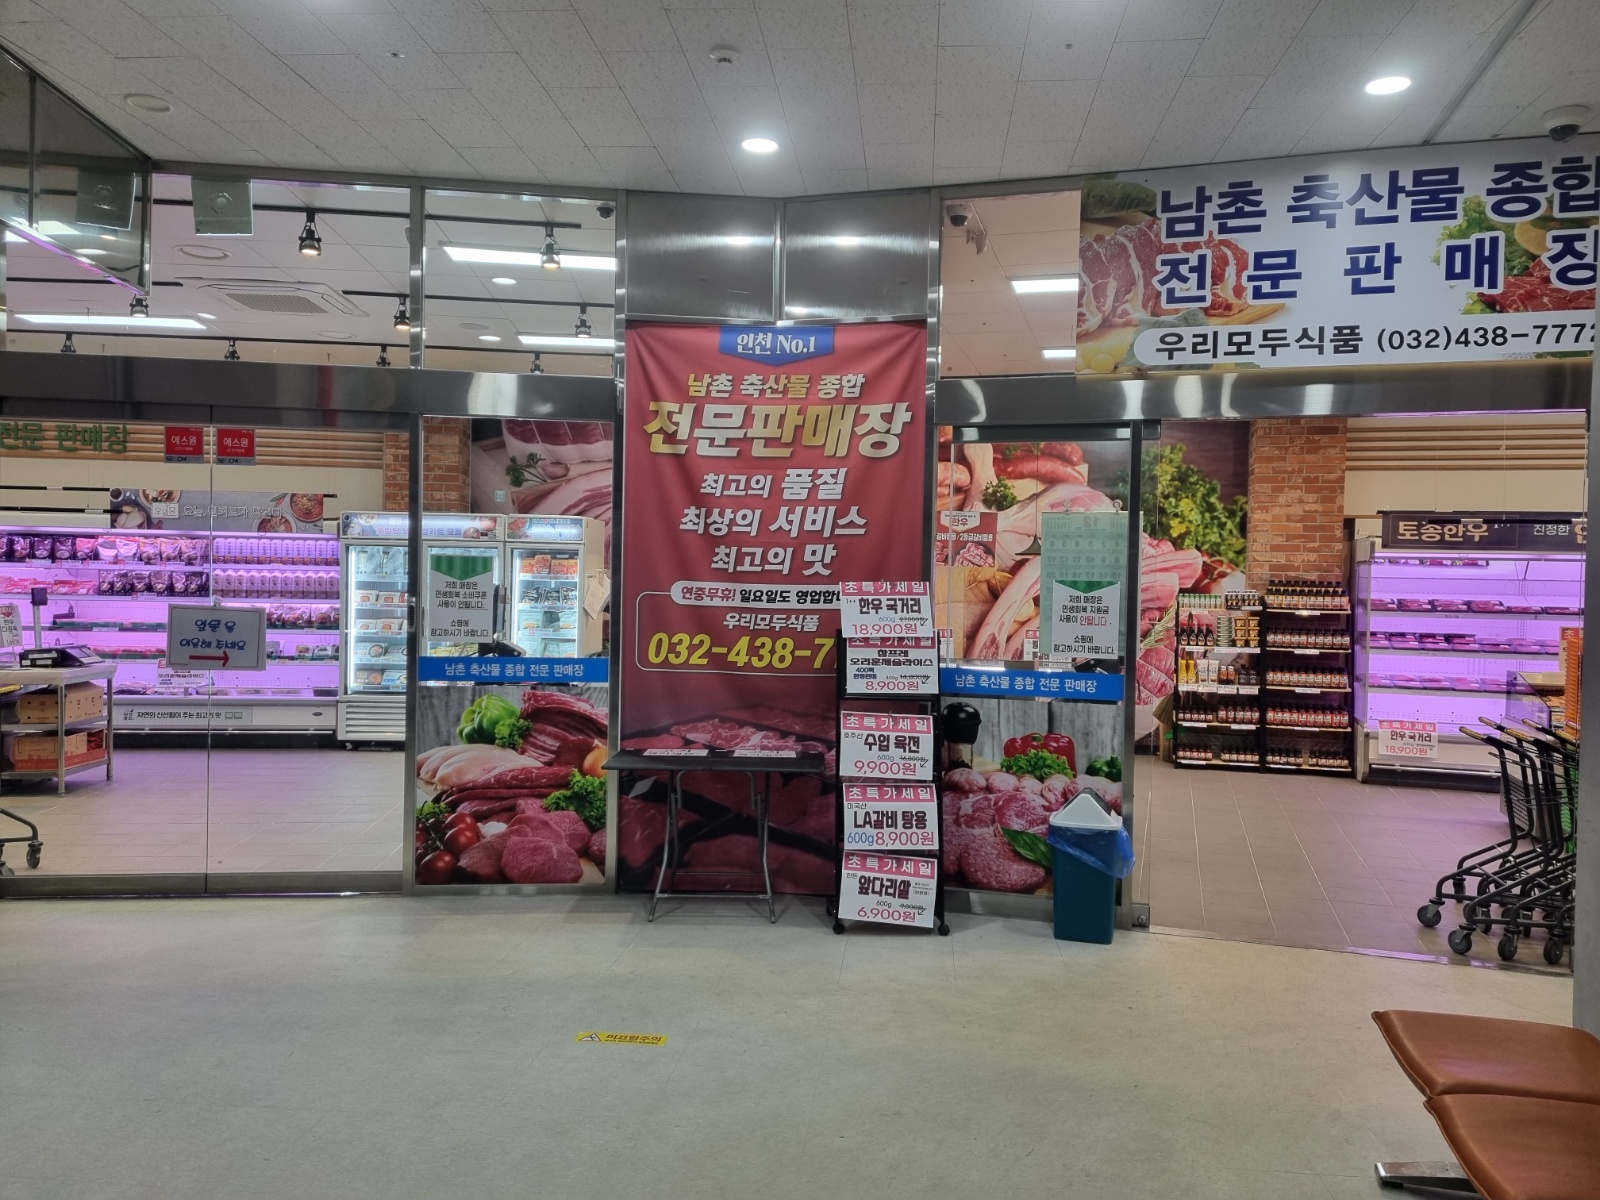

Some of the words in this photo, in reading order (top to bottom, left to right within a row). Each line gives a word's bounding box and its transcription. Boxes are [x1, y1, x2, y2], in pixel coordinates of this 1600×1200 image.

[1160, 179, 1267, 241] 남촌
[1286, 167, 1466, 229] 축산물
[1486, 156, 1600, 218] 종합
[737, 332, 772, 355] 인천
[776, 334, 816, 354] No.1
[1156, 325, 1363, 361] 우리모두식품
[688, 373, 733, 398] 남촌
[740, 374, 810, 398] 축산물
[818, 374, 865, 398] 종합
[643, 401, 912, 458] 전문판매장
[0, 421, 45, 451] 전문
[55, 424, 128, 454] 판매장
[171, 436, 197, 445] 에스원
[223, 437, 249, 447] 에스원
[700, 472, 773, 498] 최고의
[781, 467, 848, 500] 품질
[679, 506, 762, 536] 최상의
[769, 505, 868, 537] 서비스
[952, 517, 968, 527] 한우
[1533, 524, 1570, 536] 진정한
[711, 544, 794, 575] 최고의
[802, 543, 837, 576] 맛
[445, 581, 458, 589] 저희
[459, 581, 478, 590] 매장은
[435, 590, 460, 599] 민생회복
[462, 591, 487, 599] 소비쿠폰
[681, 585, 737, 602] 연중무휴!
[739, 588, 791, 604] 일요일도
[1069, 595, 1081, 604] 저희
[1083, 595, 1103, 604] 매장은
[438, 600, 456, 608] 사용이
[859, 597, 883, 614] 한우
[886, 597, 921, 614] 국거리
[1062, 604, 1087, 614] 민생회복
[1089, 605, 1109, 615] 지원금
[450, 619, 469, 627] 쇼핑에
[723, 612, 820, 632] 우리모두식품
[1059, 614, 1078, 623] 사용이
[430, 628, 461, 637] 참고하시기
[463, 628, 490, 638] 바랍니다.
[852, 623, 918, 635] 18,900원
[1074, 635, 1094, 644] 쇼핑에
[648, 632, 837, 669] 032-438-7
[877, 649, 909, 658] 참프레
[1053, 643, 1086, 653] 참고하시기
[1087, 645, 1115, 655] 바랍니다.
[850, 658, 933, 667] 오리훈제슬라이스
[445, 663, 466, 676] 남촌
[469, 663, 500, 676] 축산물
[504, 664, 525, 677] 종합
[529, 664, 549, 677] 전문
[553, 664, 584, 677] 판매장
[865, 681, 919, 691] 8,900원
[955, 674, 976, 687] 남촌
[979, 675, 1010, 688] 축산물
[1014, 676, 1035, 690] 종합
[1039, 677, 1060, 691] 전문
[1064, 678, 1098, 693] 판매장
[137, 711, 155, 719] 자연의
[182, 711, 194, 719] 주는
[846, 715, 927, 731] 초특가세일
[1390, 730, 1406, 741] 한우
[1408, 731, 1431, 742] 국거리
[864, 734, 890, 752] 수입
[894, 735, 920, 753] 육전
[1385, 745, 1428, 756] 18,900원
[854, 760, 917, 776] 9,900원
[848, 787, 931, 800] 초특가세일
[847, 802, 867, 810] 미국산
[854, 811, 898, 829] LA갈비
[901, 811, 927, 829] 탕용
[847, 832, 874, 846] 600g
[875, 831, 934, 847] 8,900원
[858, 875, 911, 900] 앞다리살
[876, 900, 892, 908] 600g
[857, 906, 916, 923] 6,900원
[606, 1034, 662, 1042] 미끄럼주의
